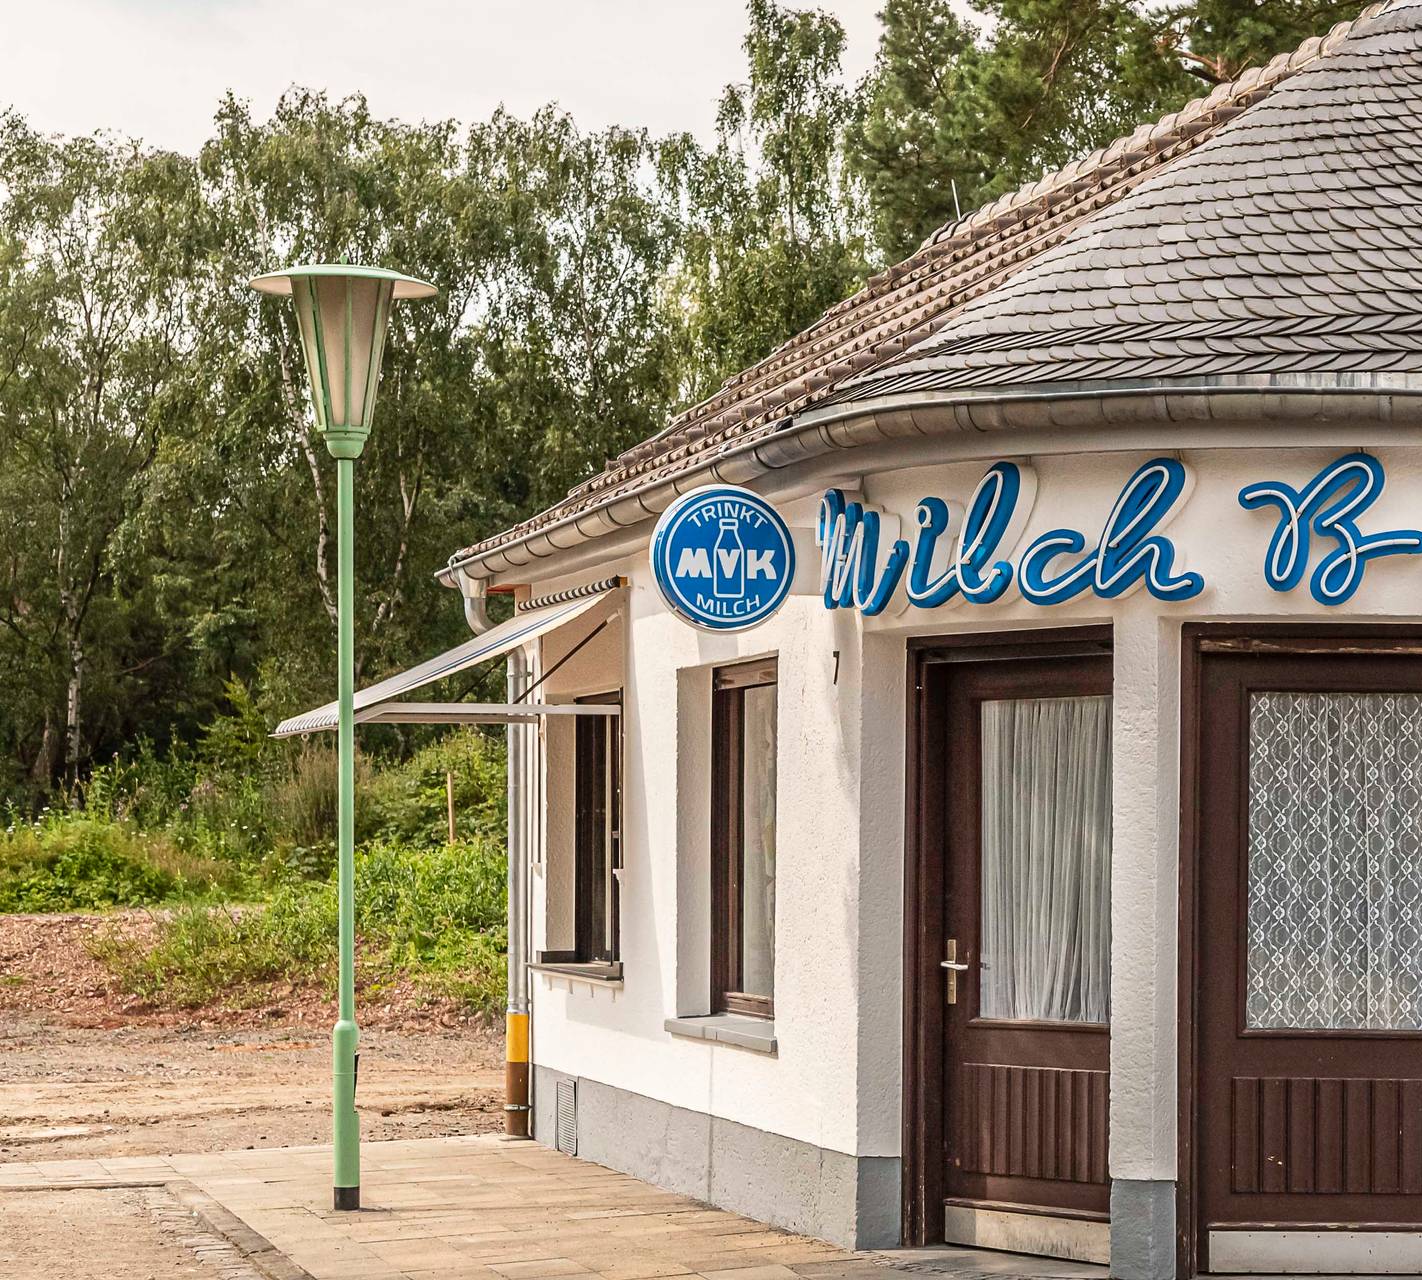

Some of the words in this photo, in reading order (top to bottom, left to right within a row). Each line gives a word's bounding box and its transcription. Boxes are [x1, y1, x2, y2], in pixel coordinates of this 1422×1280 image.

[687, 502, 769, 529] TRINKT
[819, 457, 1204, 616] Milch
[675, 547, 777, 580] MVK
[696, 593, 760, 616] MILCH
